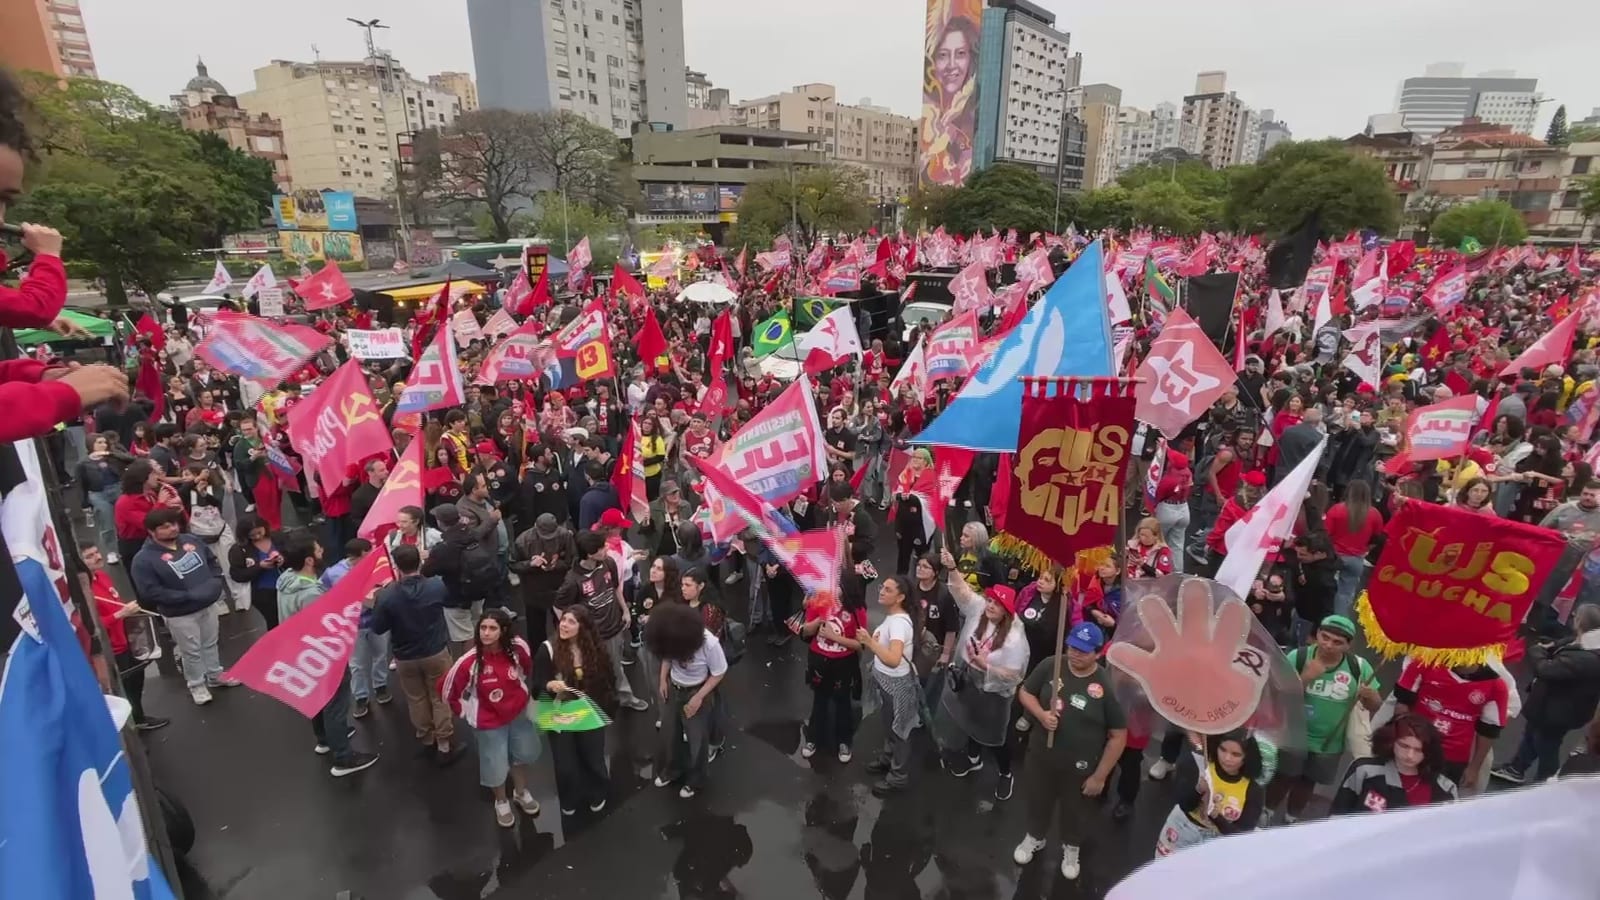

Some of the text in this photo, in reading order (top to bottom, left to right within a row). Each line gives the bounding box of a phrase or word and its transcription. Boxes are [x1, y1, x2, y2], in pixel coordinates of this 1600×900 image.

[578, 345, 598, 371] 13
[1043, 482, 1119, 535] LULA
[1408, 534, 1535, 595] UJS
